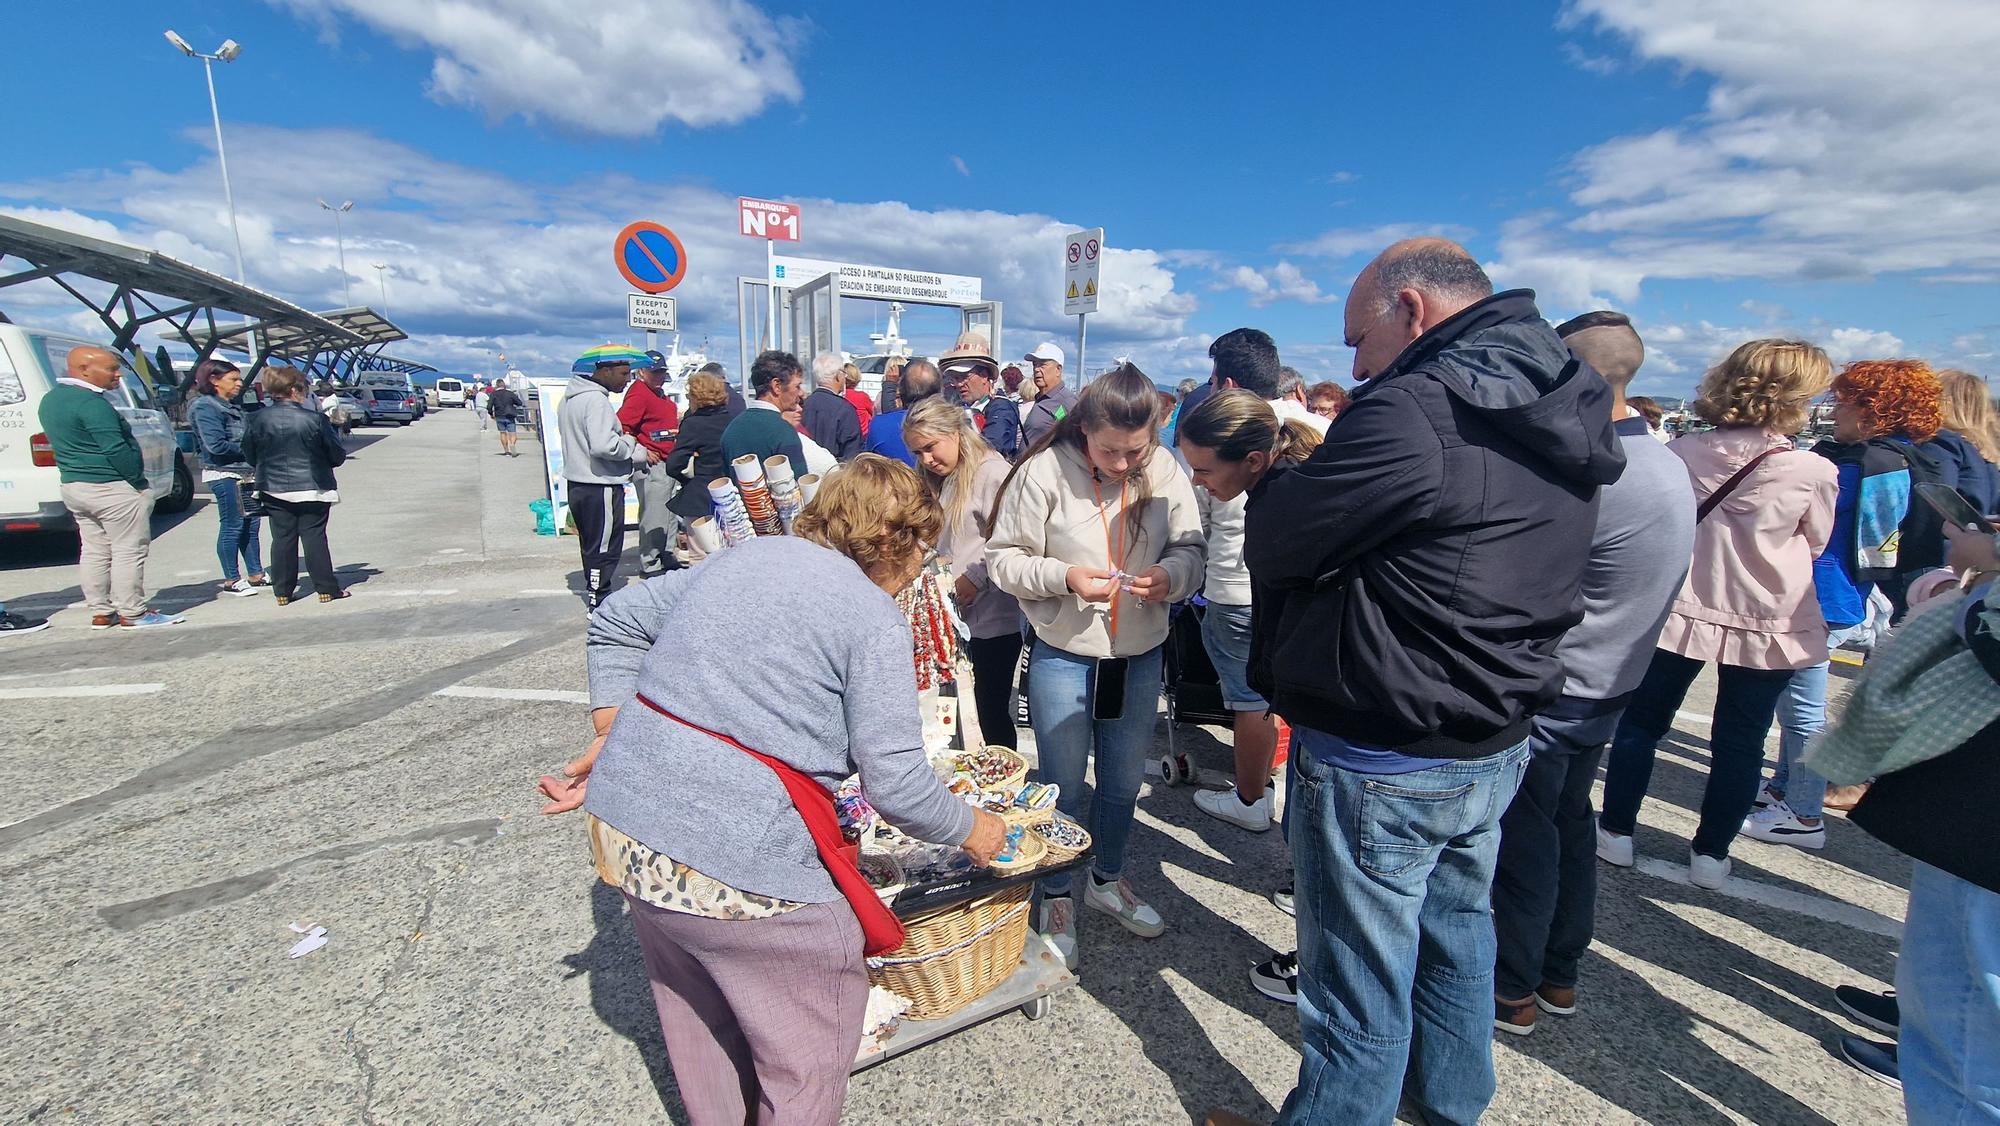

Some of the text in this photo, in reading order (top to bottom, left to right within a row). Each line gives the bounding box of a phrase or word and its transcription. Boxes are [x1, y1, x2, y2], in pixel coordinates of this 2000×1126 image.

[840, 266, 861, 277] ACCESO
[863, 269, 867, 277] A
[903, 273, 934, 285] PASAXEIROS
[935, 276, 942, 285] EN
[839, 280, 948, 299] ERACION DE EMBARQUE OU DESEMBARQUE
[636, 300, 668, 308] EXCEPTO
[634, 317, 671, 326] DESCARGA
[1021, 643, 1031, 673] LOVE
[1017, 693, 1029, 722] LOVE
[924, 882, 964, 895] DUNLOP
